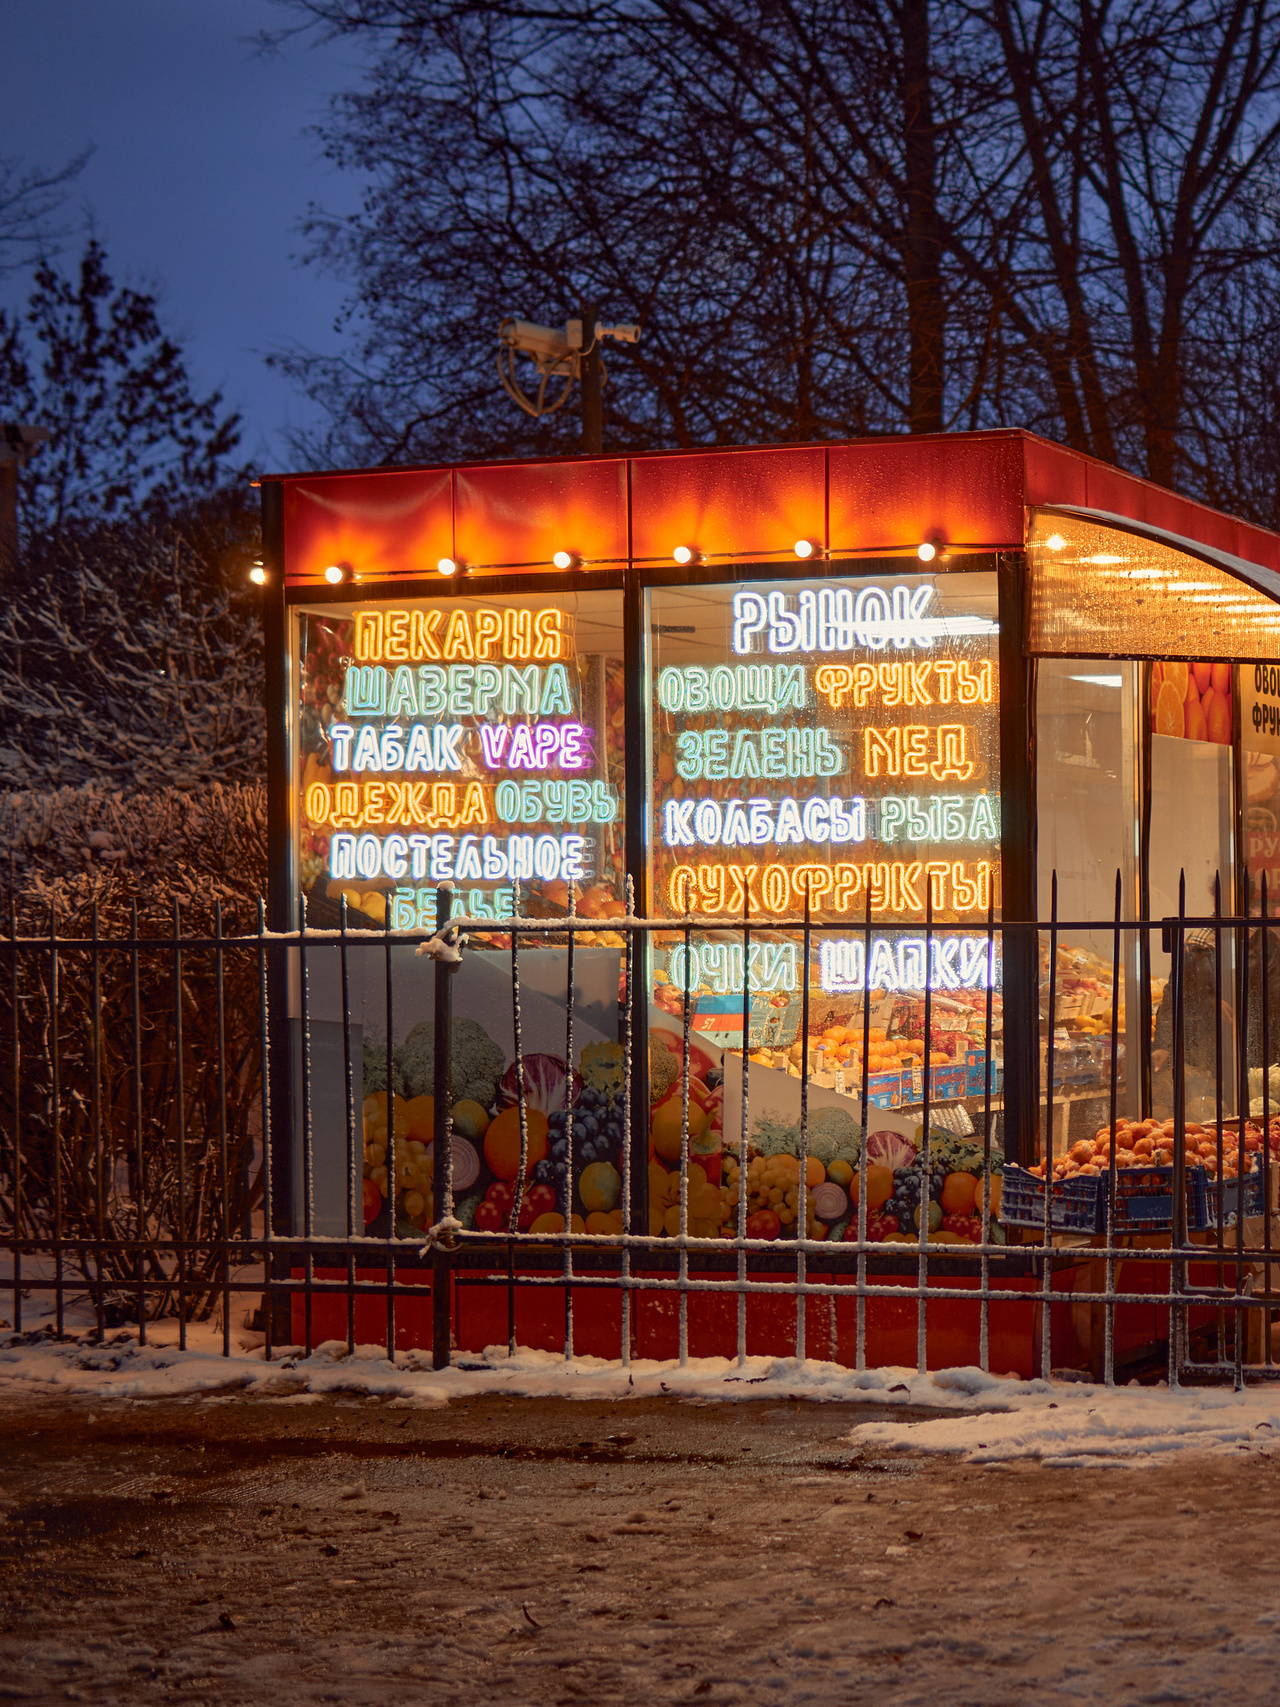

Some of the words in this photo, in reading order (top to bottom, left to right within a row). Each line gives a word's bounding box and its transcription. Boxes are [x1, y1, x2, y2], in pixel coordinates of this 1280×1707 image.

[355, 609, 563, 661] ПЕКАРНЯ
[733, 584, 934, 654] РЫНОК
[347, 664, 573, 716] ШАВЕРМА
[659, 664, 806, 715] ОВОЩИ
[815, 659, 993, 708] ФРУКТЫ
[330, 724, 464, 772] ТАБАК
[480, 724, 585, 769] VAPE
[676, 728, 844, 780] ЗЕЛЕНЬ
[864, 723, 974, 782] МЕД
[305, 781, 488, 828] ОДЕЖДА
[495, 779, 617, 823] ОБУВЬ
[664, 797, 866, 846] КОЛБАСЫ
[880, 795, 999, 843] РЫБА
[330, 833, 586, 880] ПОСТЕЛЬНОЕ
[668, 861, 993, 914] СУХОФРУКТЫ
[671, 942, 798, 994] ОЧКИ
[820, 937, 999, 992] ШАПКИ
